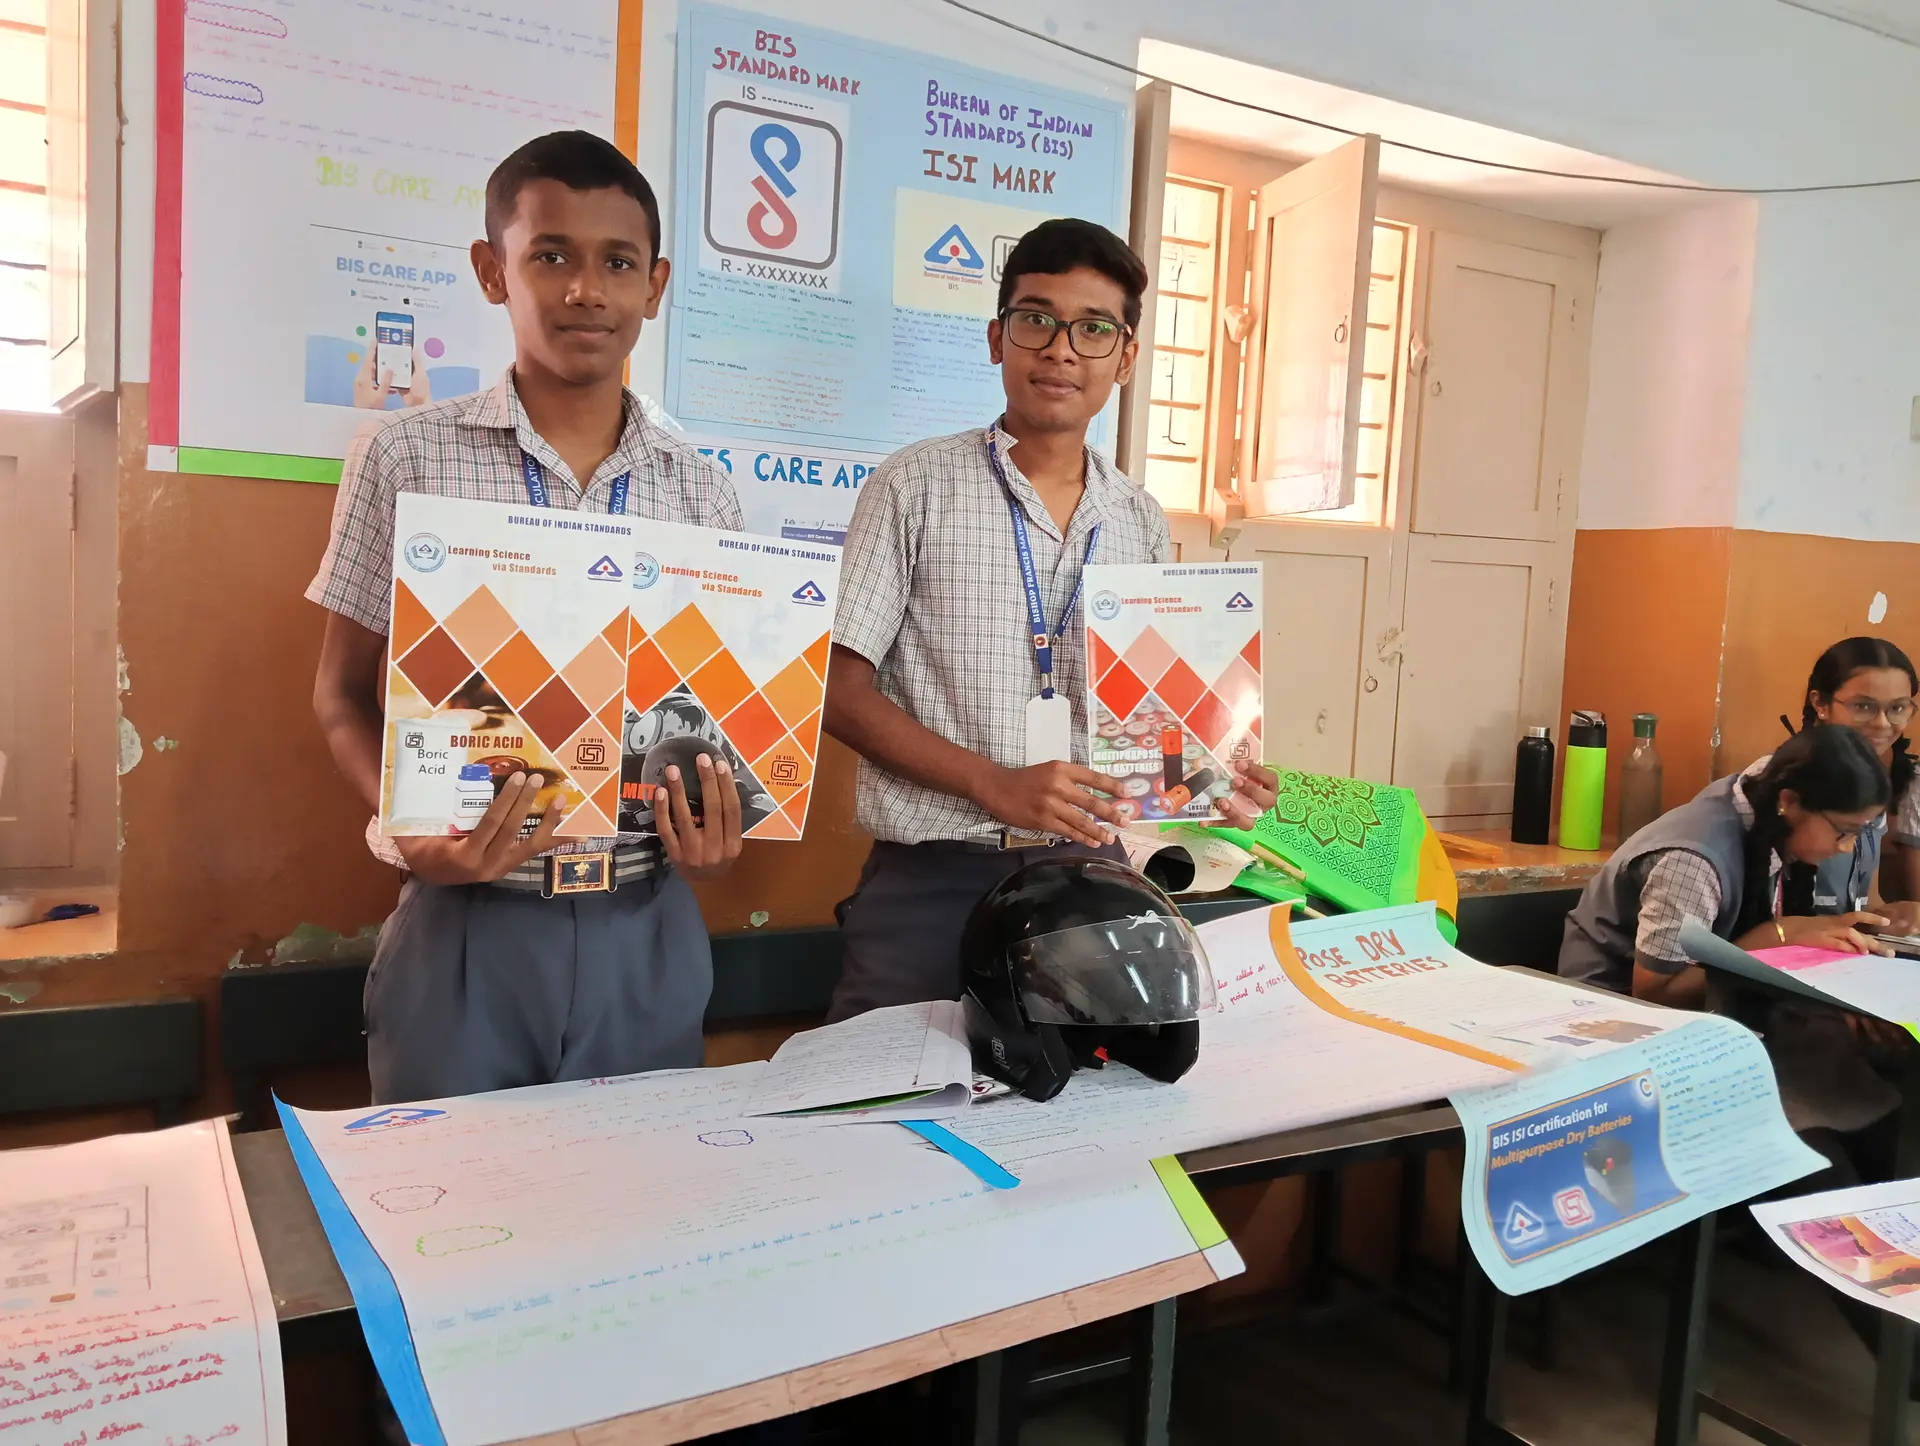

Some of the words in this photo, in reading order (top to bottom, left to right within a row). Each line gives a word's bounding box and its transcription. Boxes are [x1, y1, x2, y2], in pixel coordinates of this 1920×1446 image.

[755, 30, 797, 57] BIS
[712, 47, 811, 86] STANDARD
[816, 73, 861, 96] MARK
[741, 86, 757, 101] IS
[926, 80, 990, 117] BUREAU
[999, 103, 1019, 121] OF
[1027, 109, 1093, 138] INDIAN
[925, 110, 1026, 149] STANDARDS
[373, 169, 438, 203] CARE
[923, 149, 978, 184] ISI
[993, 162, 1057, 195] MARK
[336, 256, 365, 274] BIS
[368, 262, 417, 282] CARE
[421, 269, 457, 287] APP
[721, 257, 732, 273] R
[754, 452, 823, 486] CARE
[832, 464, 878, 488] AP
[508, 515, 541, 527] BUREAU
[543, 519, 553, 528] OF
[554, 520, 583, 531] INDIAN
[584, 523, 632, 536] STANDARDS
[448, 545, 491, 559] Learning
[492, 549, 531, 561] Science
[719, 539, 750, 551] BUREAU
[751, 543, 761, 552] OF
[762, 545, 790, 556] INDIAN
[791, 549, 837, 563] STANDARDS
[492, 563, 507, 573] via
[509, 563, 557, 576] Standards
[661, 565, 701, 579] Learning
[702, 570, 739, 583] Science
[1021, 551, 1038, 589] FRANCIS
[701, 582, 715, 592] via
[717, 583, 763, 598] Standards
[1029, 589, 1041, 624] BISHOP
[417, 748, 449, 760] Boric
[450, 735, 490, 749] BORIC
[492, 735, 524, 749] ACID
[418, 764, 446, 775] Acid
[622, 782, 657, 800] MET
[1355, 927, 1405, 961] DRY
[1324, 955, 1448, 989] BATTERIES
[1493, 1132, 1509, 1149] BIS
[1512, 1128, 1525, 1143] ISI
[1527, 1108, 1592, 1137] Certification
[1594, 1100, 1608, 1115] for
[1491, 1137, 1564, 1170] Multipurpose
[1566, 1130, 1585, 1146] Dry
[1587, 1114, 1633, 1138] Batteries
